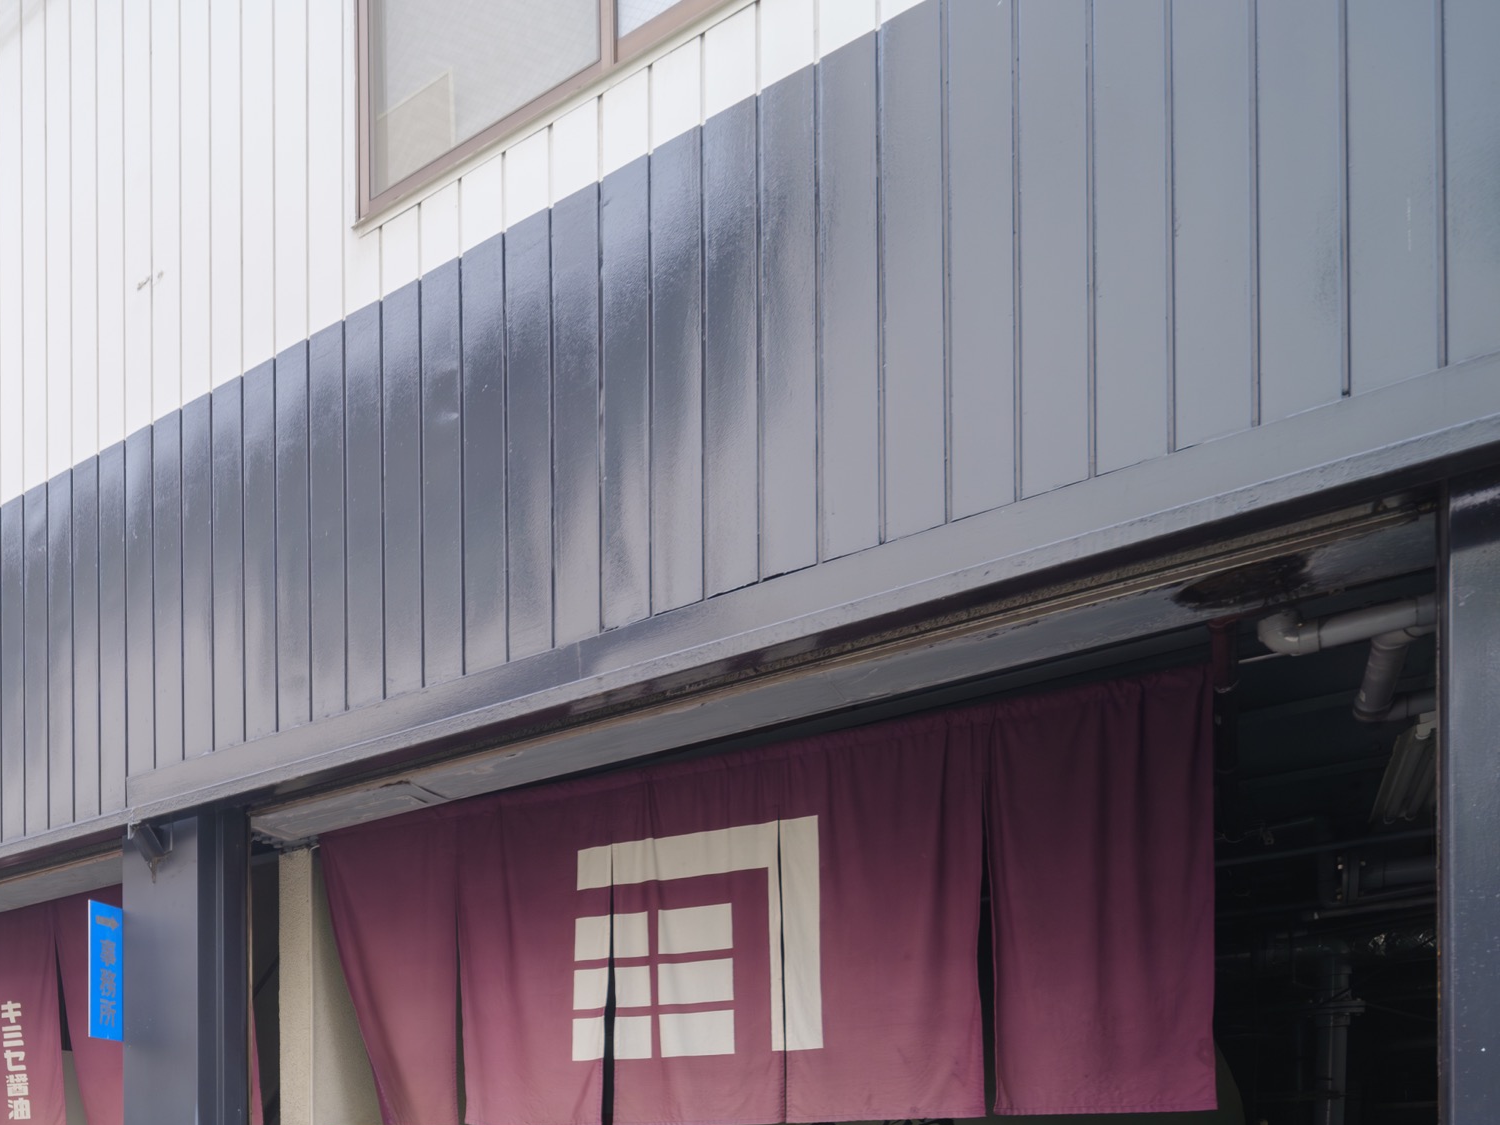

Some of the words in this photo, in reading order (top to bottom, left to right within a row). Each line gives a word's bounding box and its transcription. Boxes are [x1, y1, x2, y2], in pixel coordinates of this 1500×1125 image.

[100, 939, 117, 1028] 事務所
[0, 1000, 32, 1121] キミセ醤油
